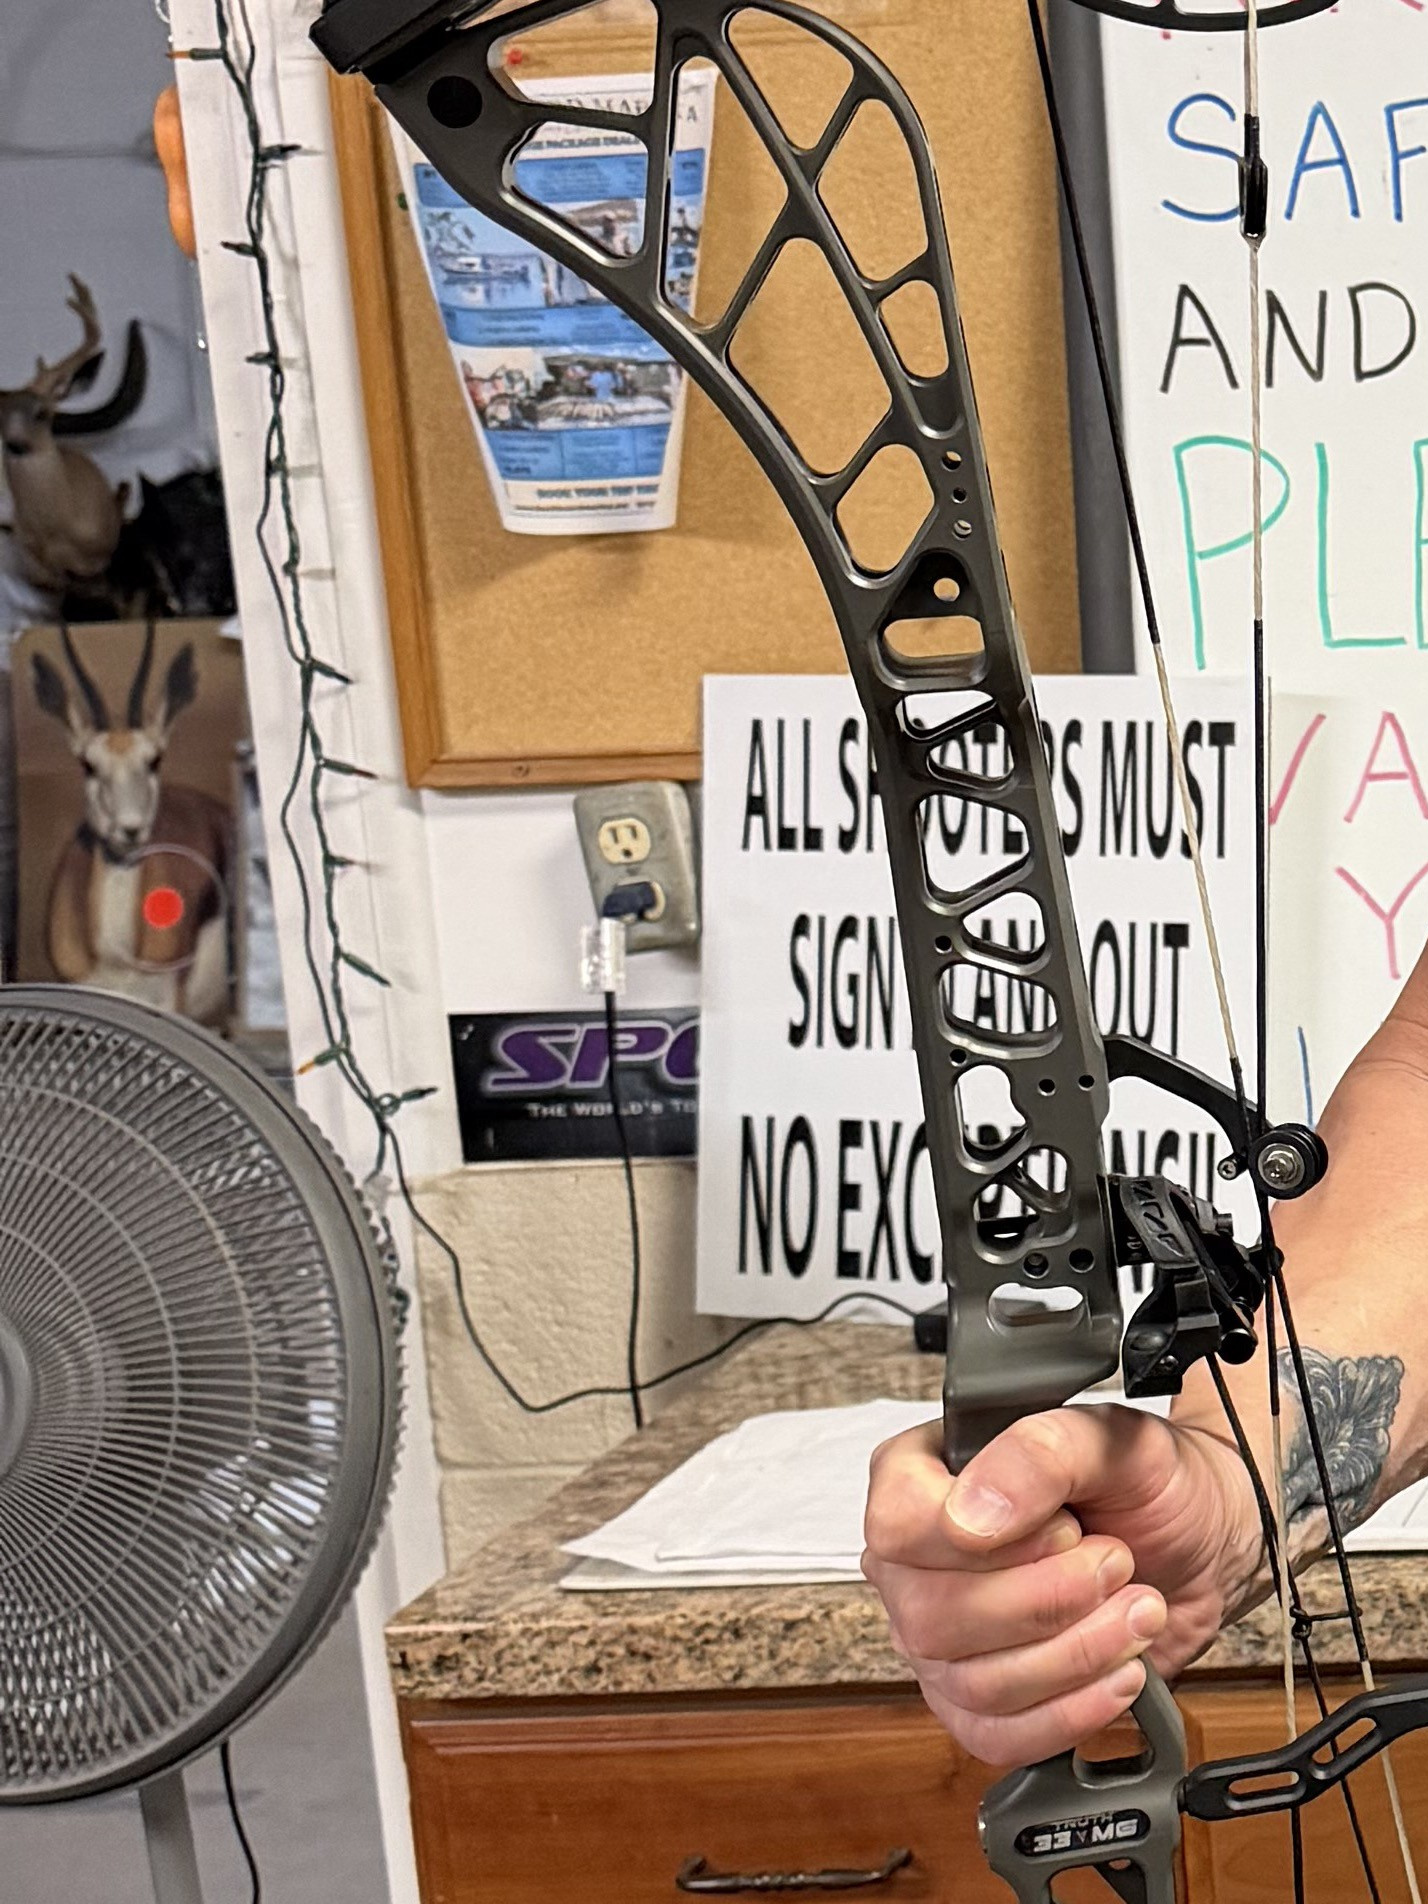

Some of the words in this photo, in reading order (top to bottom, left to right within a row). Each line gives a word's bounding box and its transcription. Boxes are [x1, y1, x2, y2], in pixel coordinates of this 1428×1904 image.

[1159, 281, 1419, 395] AND
[741, 718, 824, 853] ALL
[1100, 720, 1238, 860] MUST
[787, 912, 897, 1051] SIGN
[1090, 918, 1192, 1058] OUT
[737, 1113, 820, 1277] NO
[1033, 1830, 1072, 1853] 33
